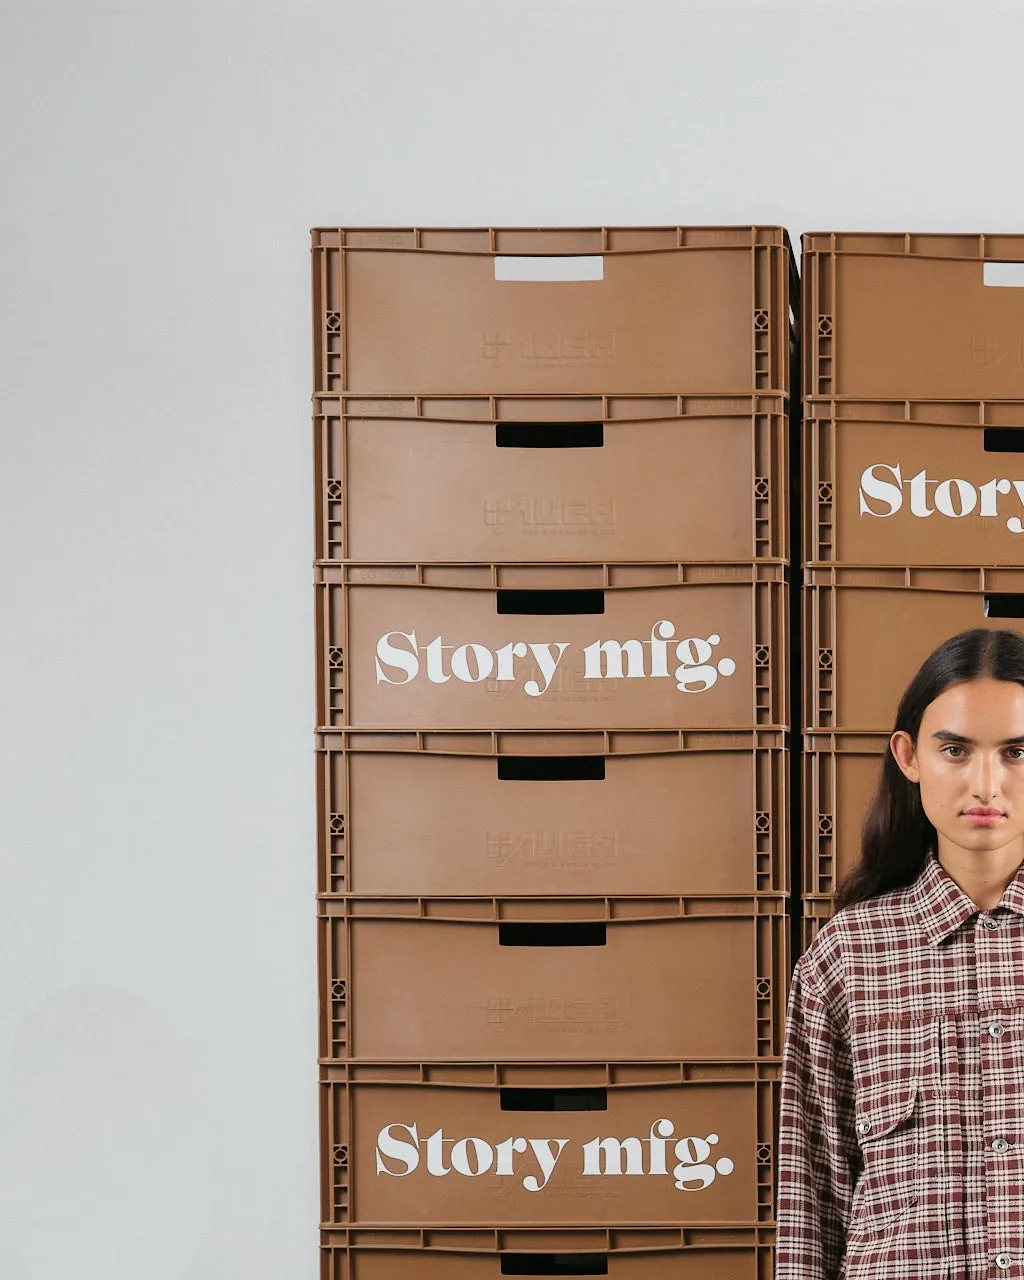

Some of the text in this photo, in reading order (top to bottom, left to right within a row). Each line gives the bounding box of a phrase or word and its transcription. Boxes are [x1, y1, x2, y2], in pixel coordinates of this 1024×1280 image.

[375, 631, 570, 697] Story
[582, 619, 736, 693] mfg.
[376, 1123, 569, 1191] Story
[582, 1119, 734, 1191] mfg.
